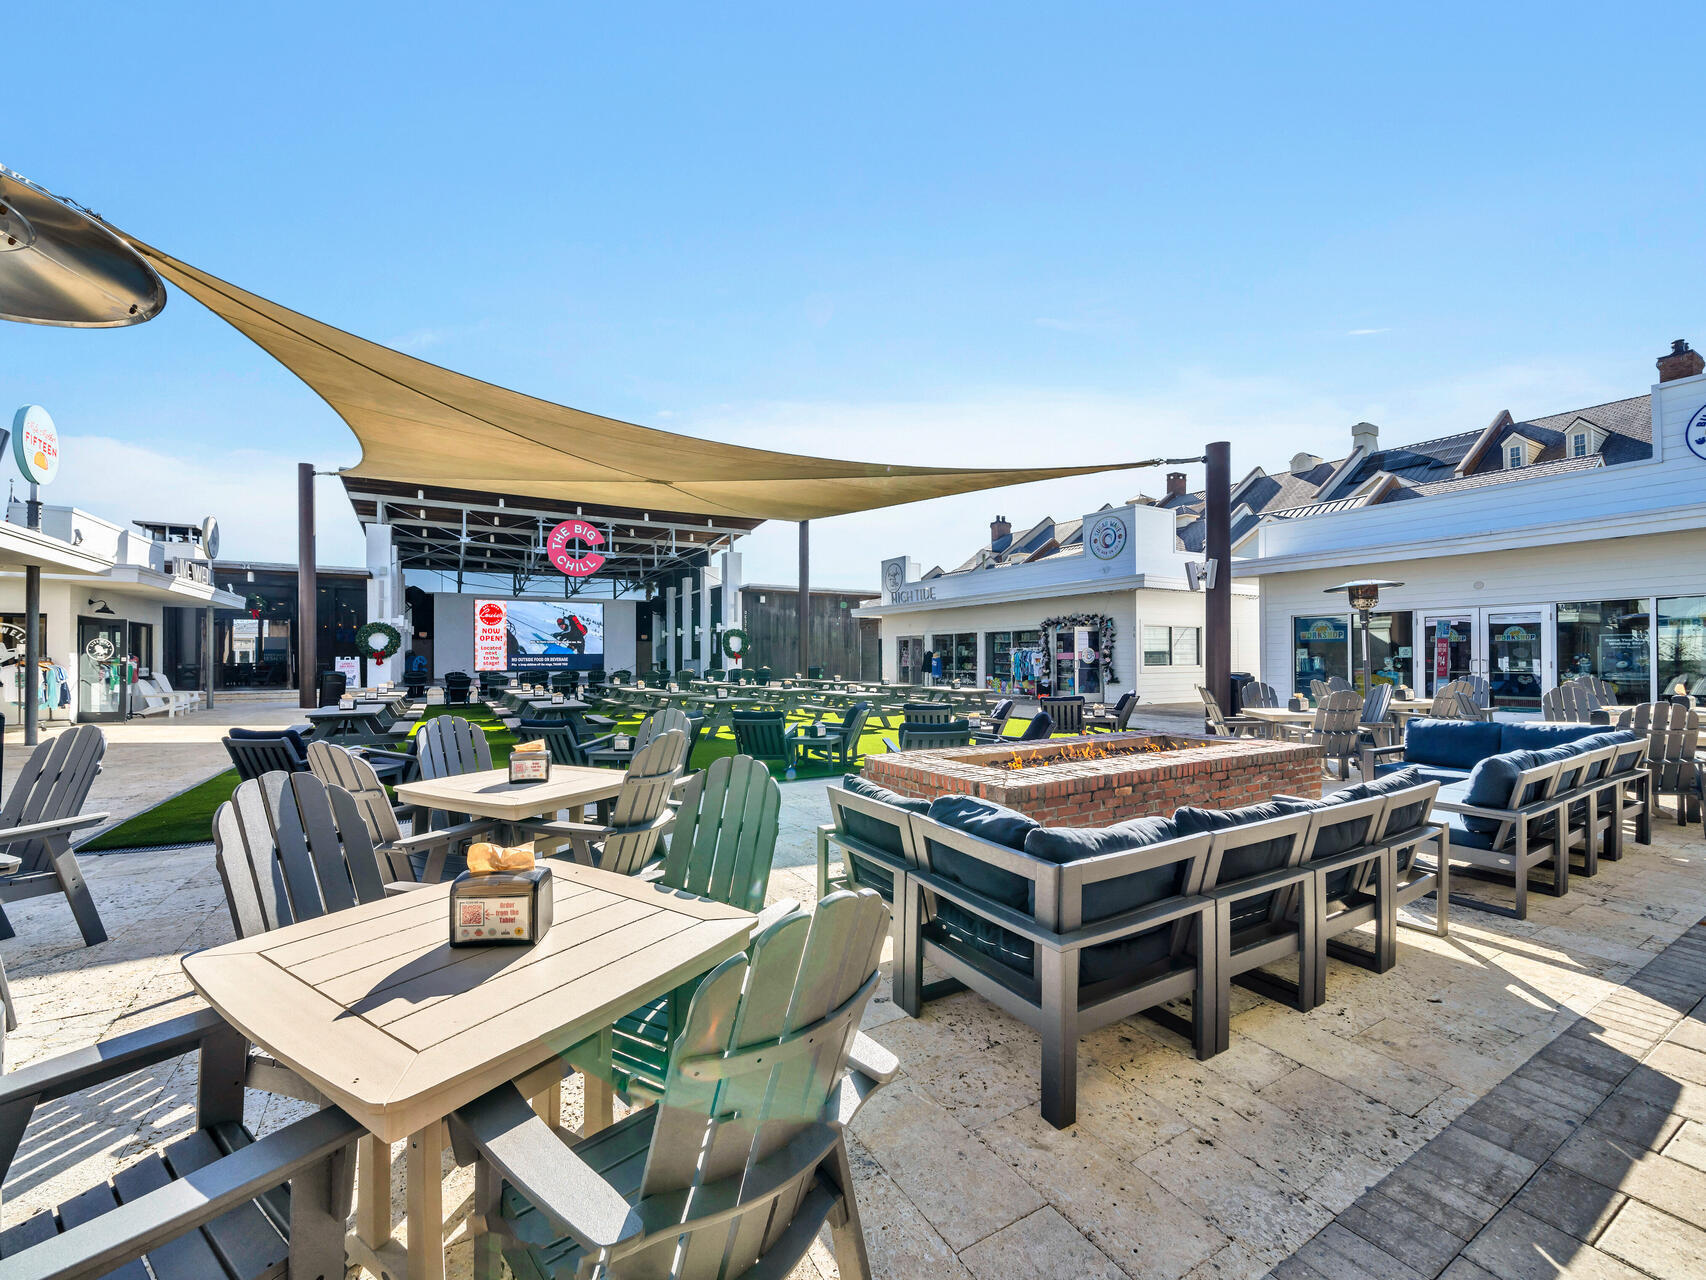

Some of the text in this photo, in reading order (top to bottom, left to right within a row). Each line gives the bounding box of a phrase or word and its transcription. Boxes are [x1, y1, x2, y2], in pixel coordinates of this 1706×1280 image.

[25, 431, 57, 457] FIFTEEN
[552, 524, 596, 549] THE BIG
[557, 555, 596, 572] CHILL
[191, 562, 215, 586] WEL
[891, 587, 937, 604] HIGH TIDE
[1300, 631, 1345, 640] WORKSHOP
[1495, 633, 1536, 641] WORKSHOP
